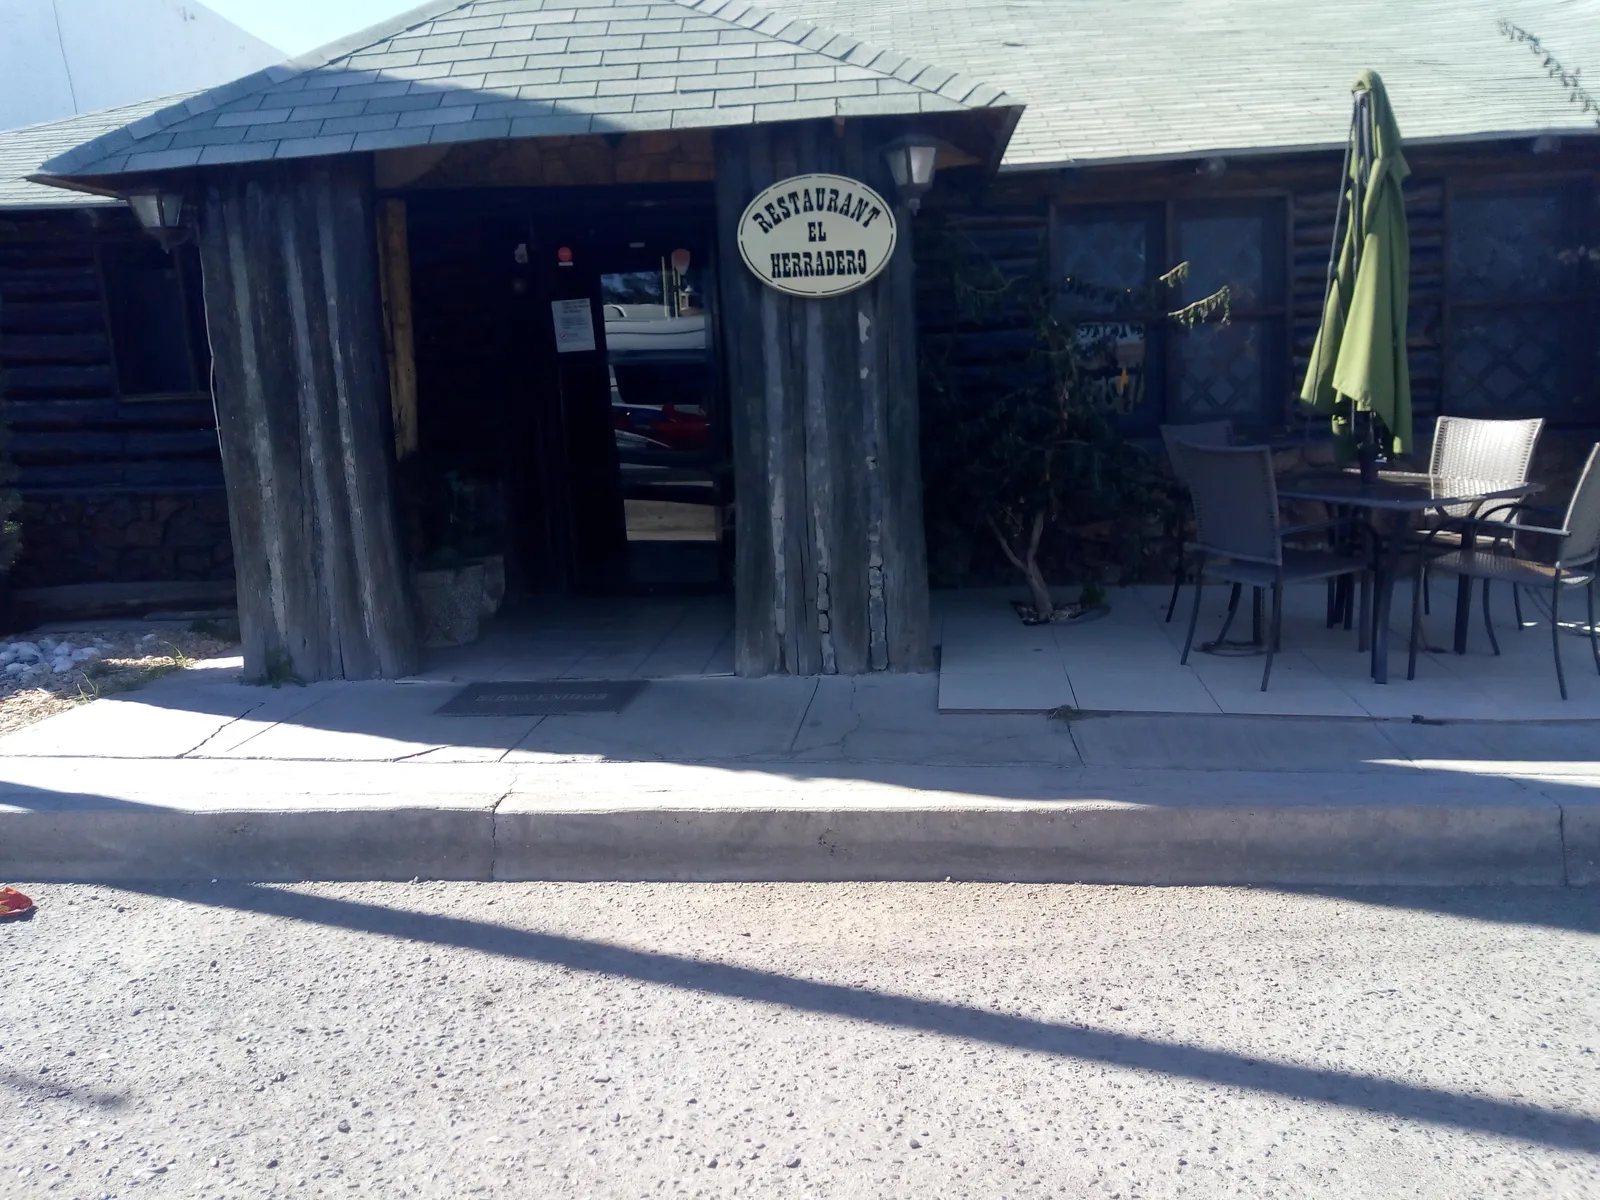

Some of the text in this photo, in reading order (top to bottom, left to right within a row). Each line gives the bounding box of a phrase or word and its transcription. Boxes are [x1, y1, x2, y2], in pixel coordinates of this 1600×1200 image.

[752, 187, 881, 234] RESTAURANT
[807, 221, 827, 242] EL
[770, 249, 867, 279] HERRADERO
